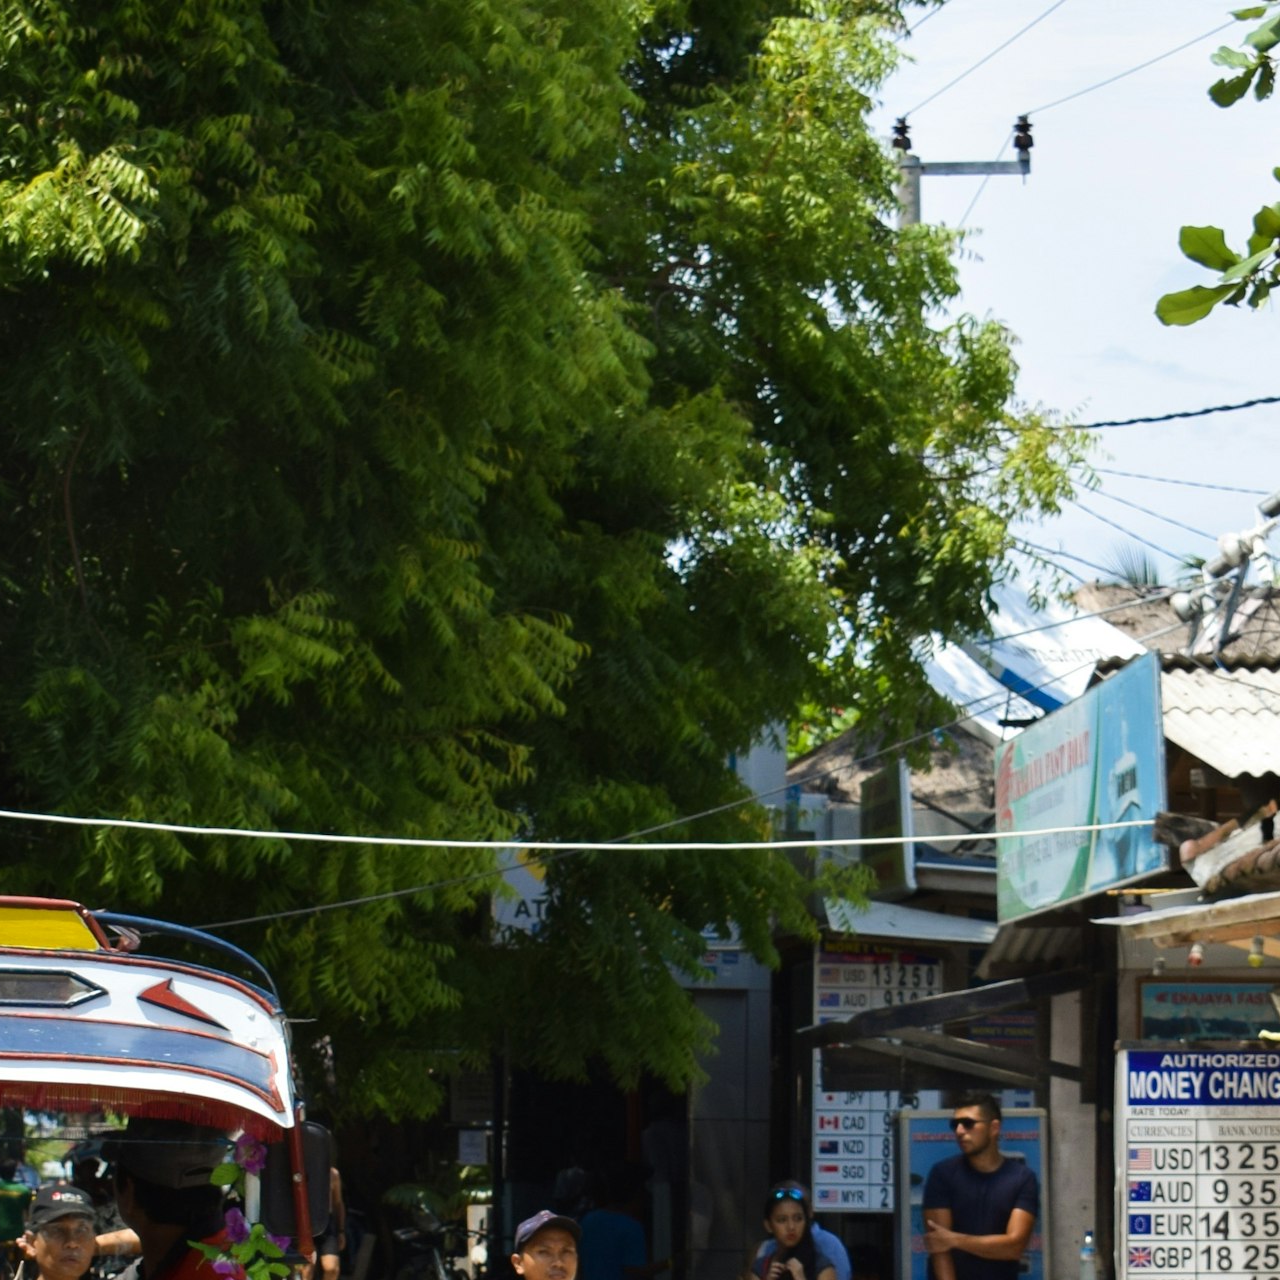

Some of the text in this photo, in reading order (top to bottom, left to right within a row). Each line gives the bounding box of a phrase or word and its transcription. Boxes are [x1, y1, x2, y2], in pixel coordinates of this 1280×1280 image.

[843, 966, 866, 982] USD
[843, 991, 867, 1007] AUD
[1160, 1054, 1280, 1068] AUTHORIZED
[1130, 1071, 1204, 1099] MONEY
[1131, 1108, 1155, 1116] RATE
[842, 1115, 865, 1130] CAD
[1130, 1125, 1193, 1137] CURRENCIES
[1218, 1125, 1246, 1137] BANK
[842, 1139, 865, 1154] NZD
[1154, 1148, 1193, 1170] USD
[842, 1165, 865, 1179] SGD
[841, 1190, 865, 1204] MYR
[1152, 1181, 1193, 1203] AUD
[1154, 1214, 1193, 1236] EUR
[1152, 1247, 1193, 1269] GBP
